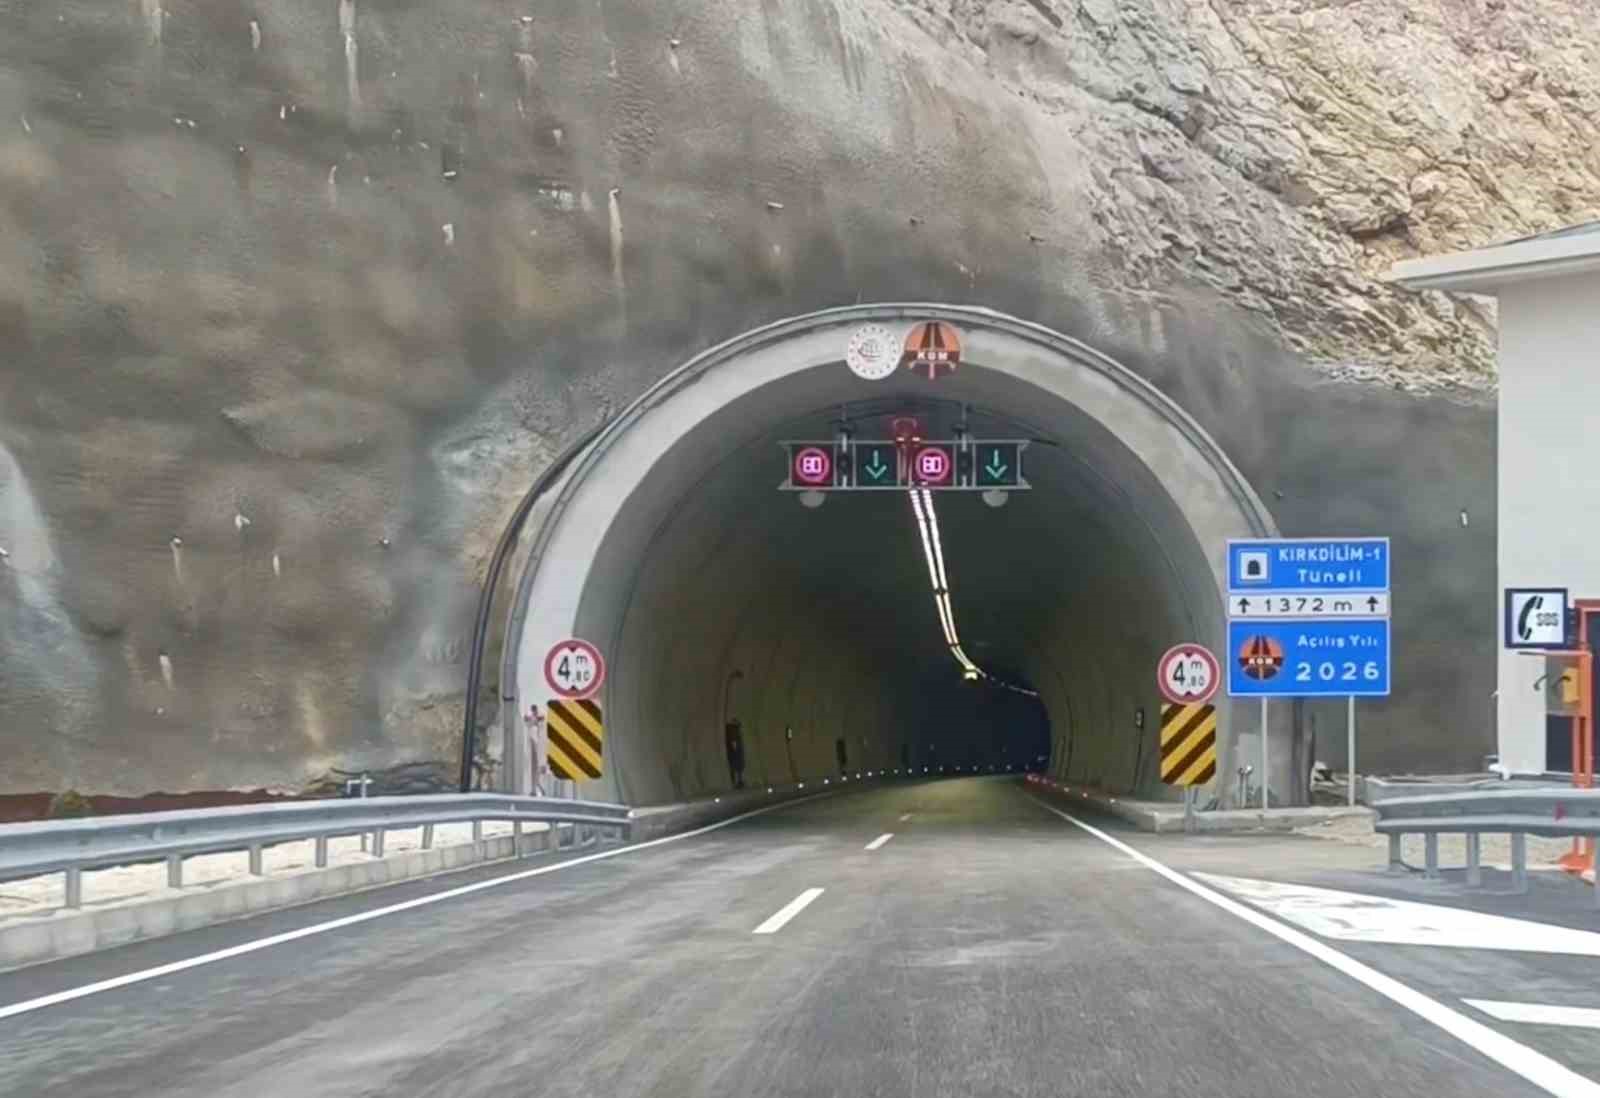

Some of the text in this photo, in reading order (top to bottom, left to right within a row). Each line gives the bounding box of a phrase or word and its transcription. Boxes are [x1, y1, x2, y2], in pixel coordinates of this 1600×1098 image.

[802, 456, 822, 474] 80
[922, 456, 942, 474] 80
[1278, 544, 1381, 561] KIRKDİLİM-1
[1264, 597, 1353, 612] 1372 m
[1536, 612, 1559, 627] SOS
[558, 656, 570, 682] 4
[1173, 661, 1185, 686] 4
[1295, 661, 1380, 682] 2026
